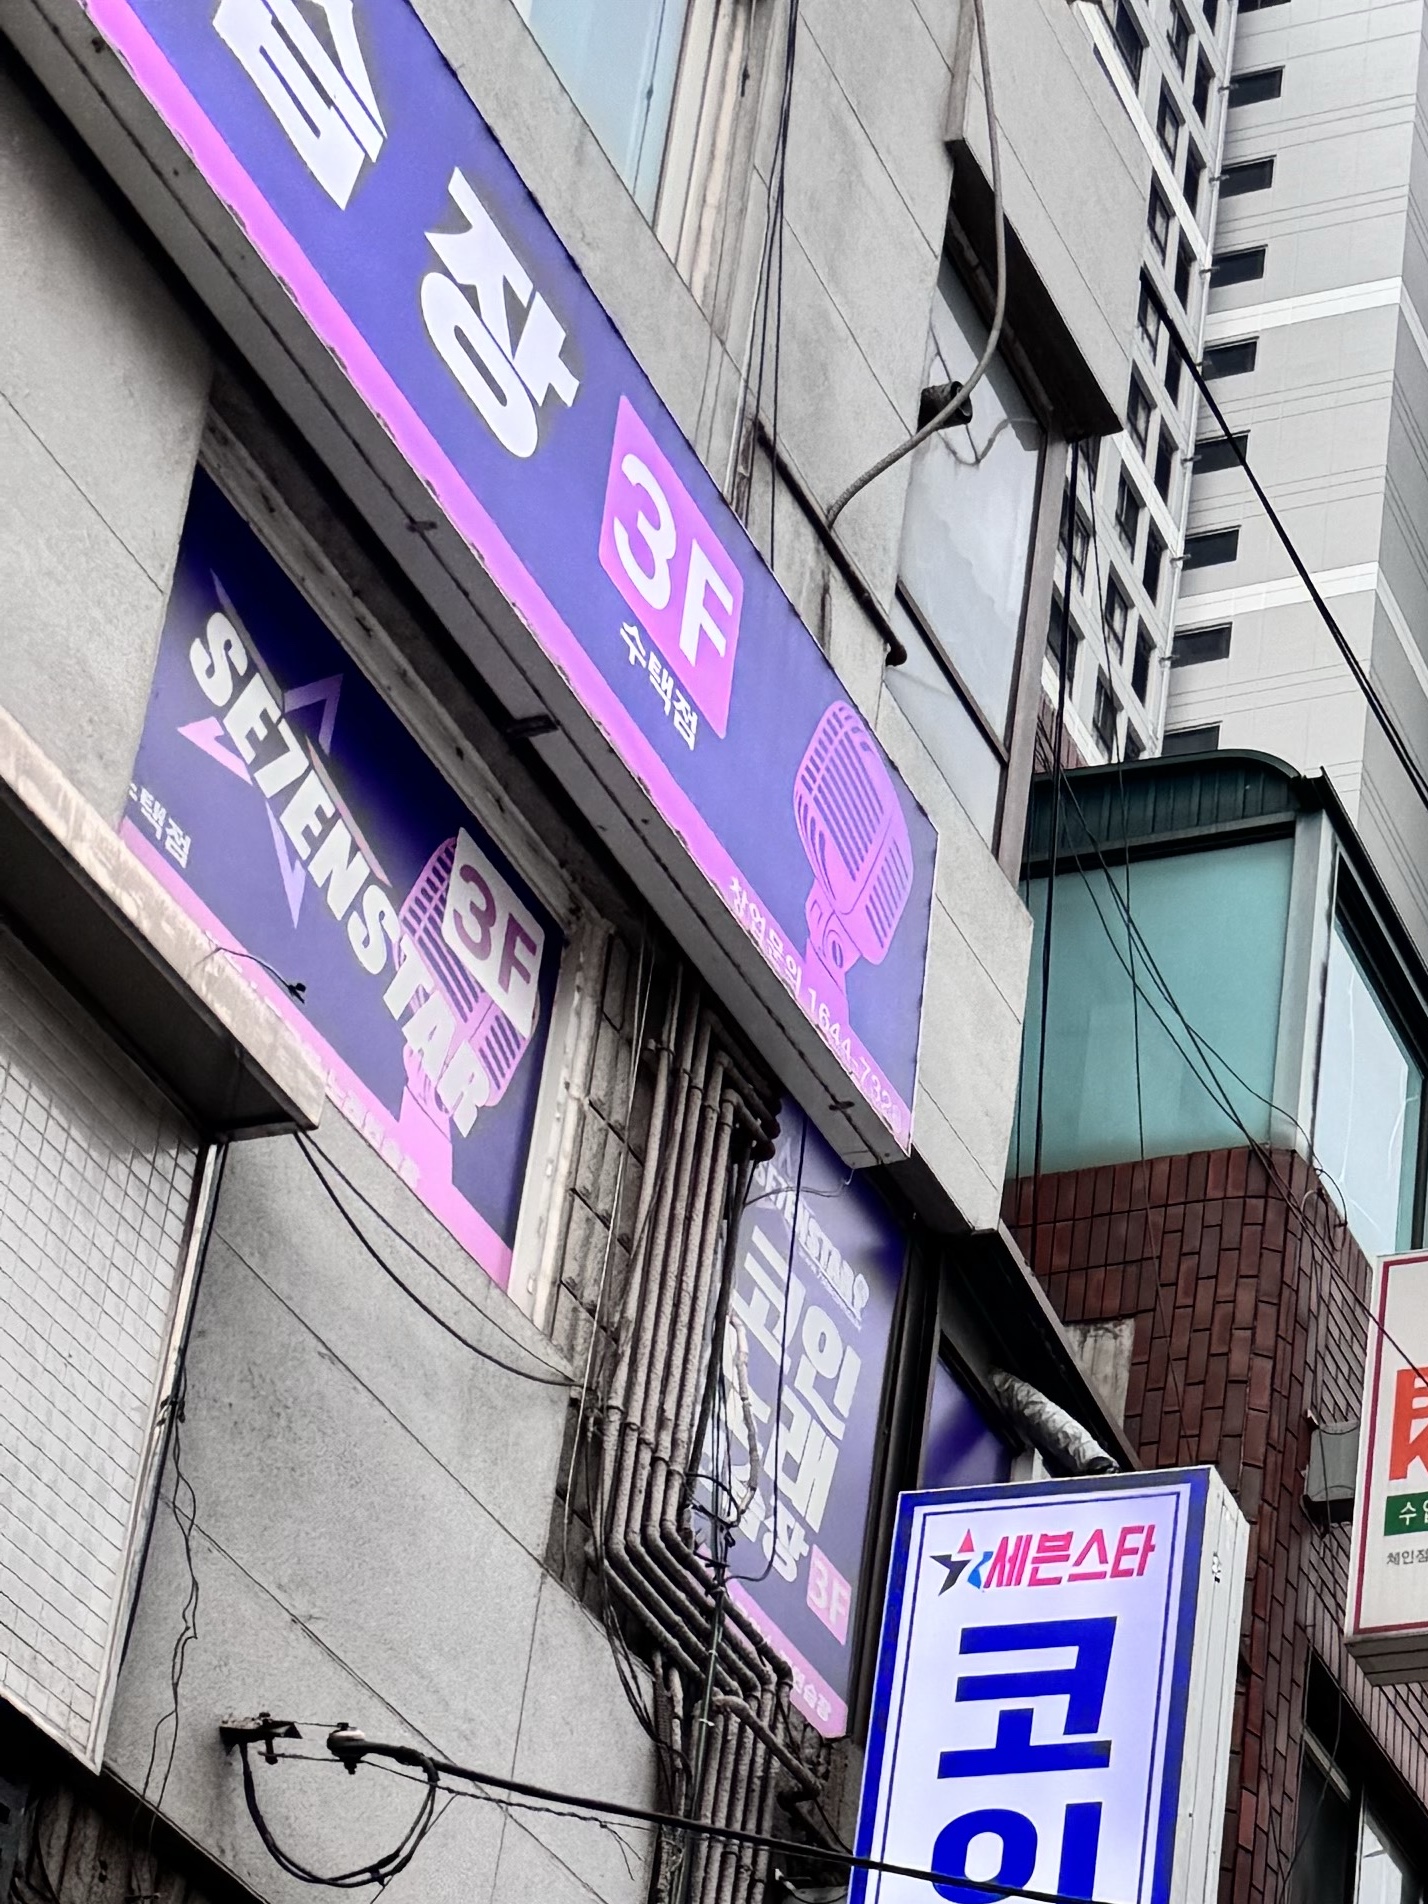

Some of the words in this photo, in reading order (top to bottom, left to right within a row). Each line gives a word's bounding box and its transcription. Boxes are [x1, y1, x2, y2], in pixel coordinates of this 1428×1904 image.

[612, 453, 735, 668] 3F
[618, 621, 698, 753] 수택점
[453, 864, 538, 995] 3F
[808, 987, 904, 1128] 1644-732
[809, 1556, 851, 1628] 3F
[981, 1523, 1157, 1589] 세븐스타
